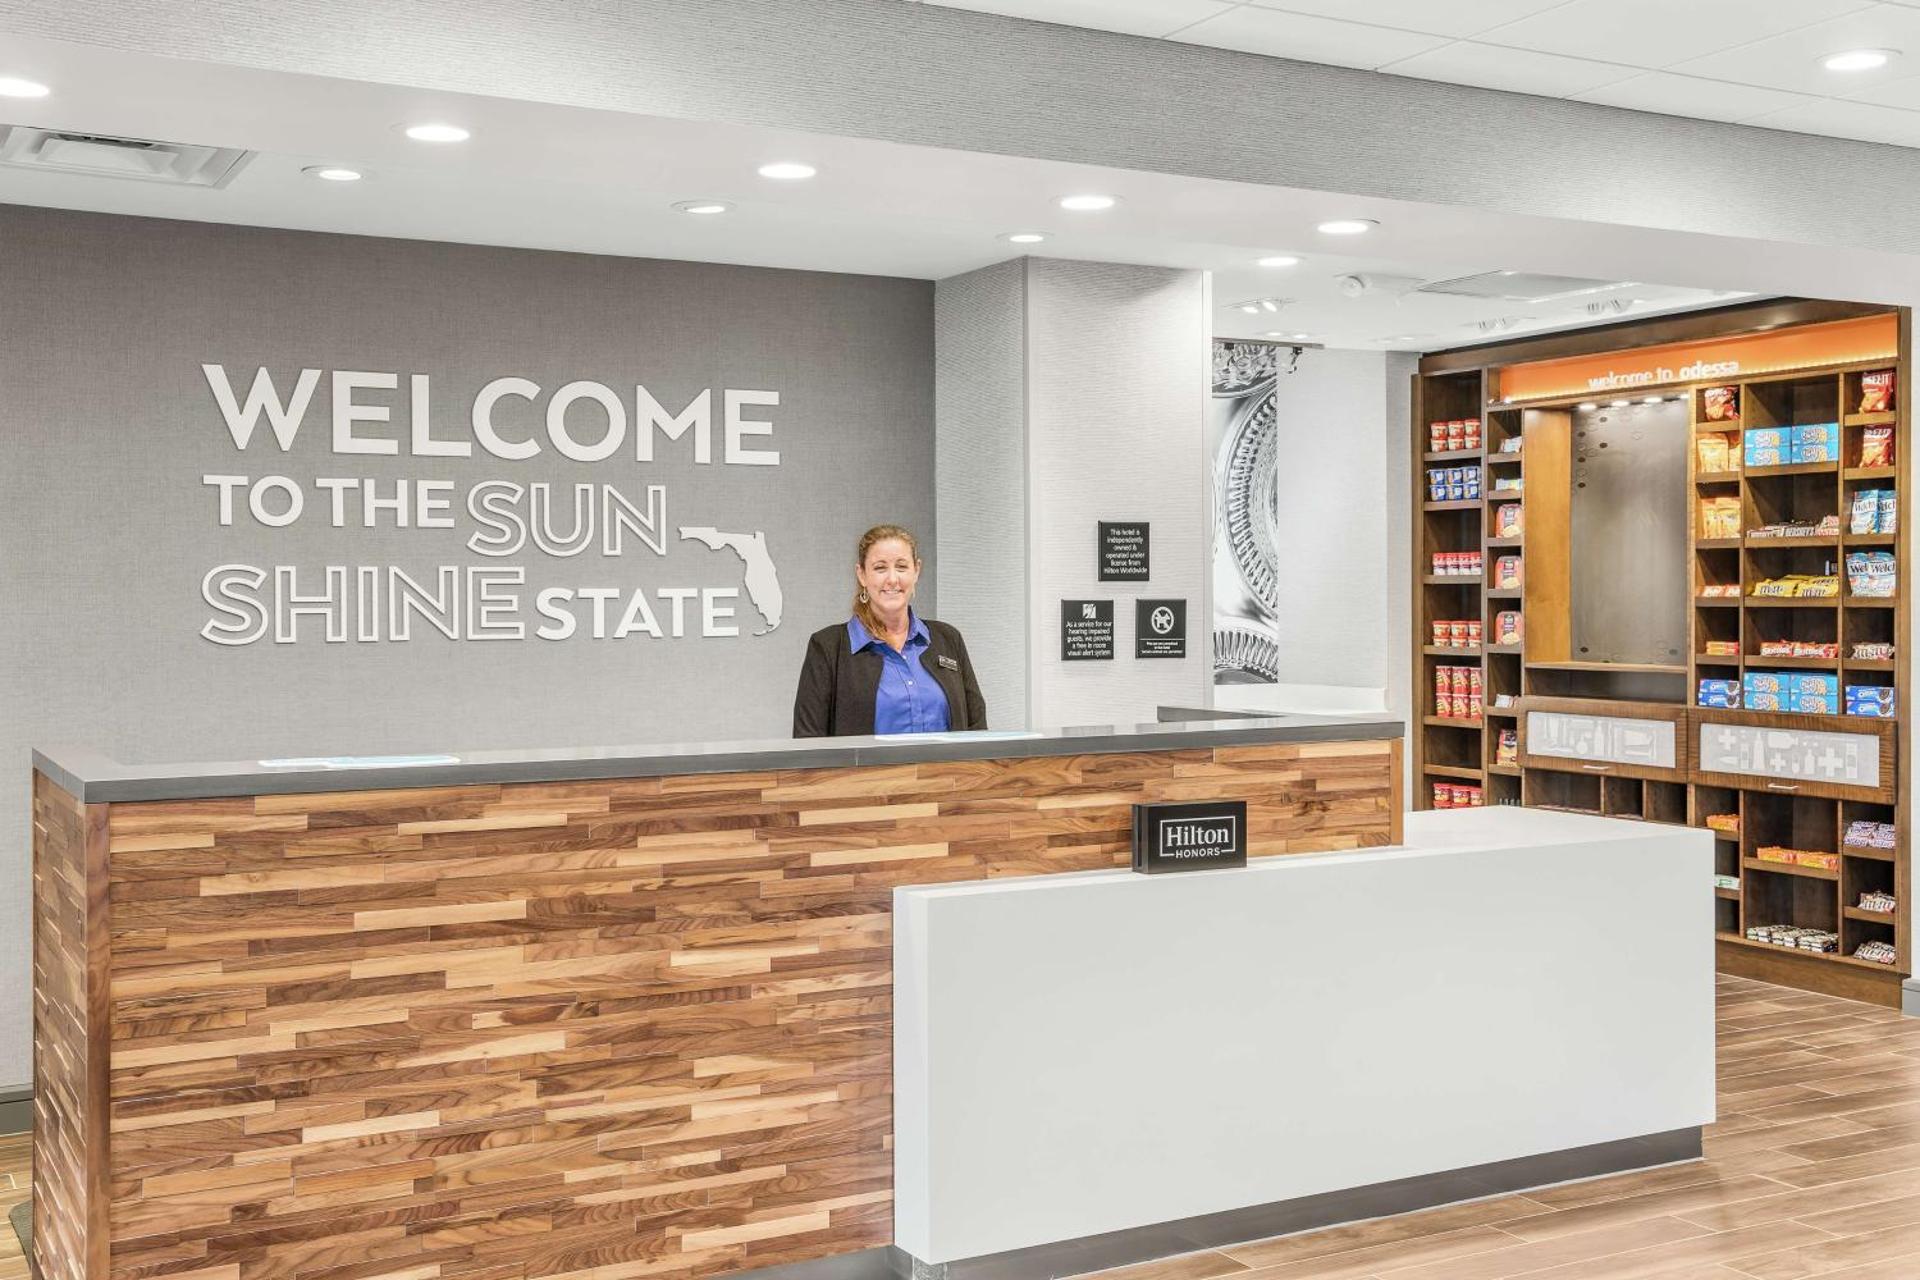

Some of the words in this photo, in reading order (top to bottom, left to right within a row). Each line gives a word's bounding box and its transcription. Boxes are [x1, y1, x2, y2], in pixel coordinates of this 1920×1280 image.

[1588, 371, 1652, 391] welcome
[1655, 367, 1673, 383] to
[201, 364, 780, 465] WELCOME
[203, 474, 304, 527] TO
[315, 478, 455, 528] THE
[466, 480, 666, 557] SUN
[1106, 536, 1144, 545] independently
[1105, 552, 1129, 560] operated
[200, 564, 526, 645] SHINE
[535, 587, 740, 638] STATE
[1166, 825, 1230, 847] Hilton
[1175, 847, 1221, 859] HONORS
